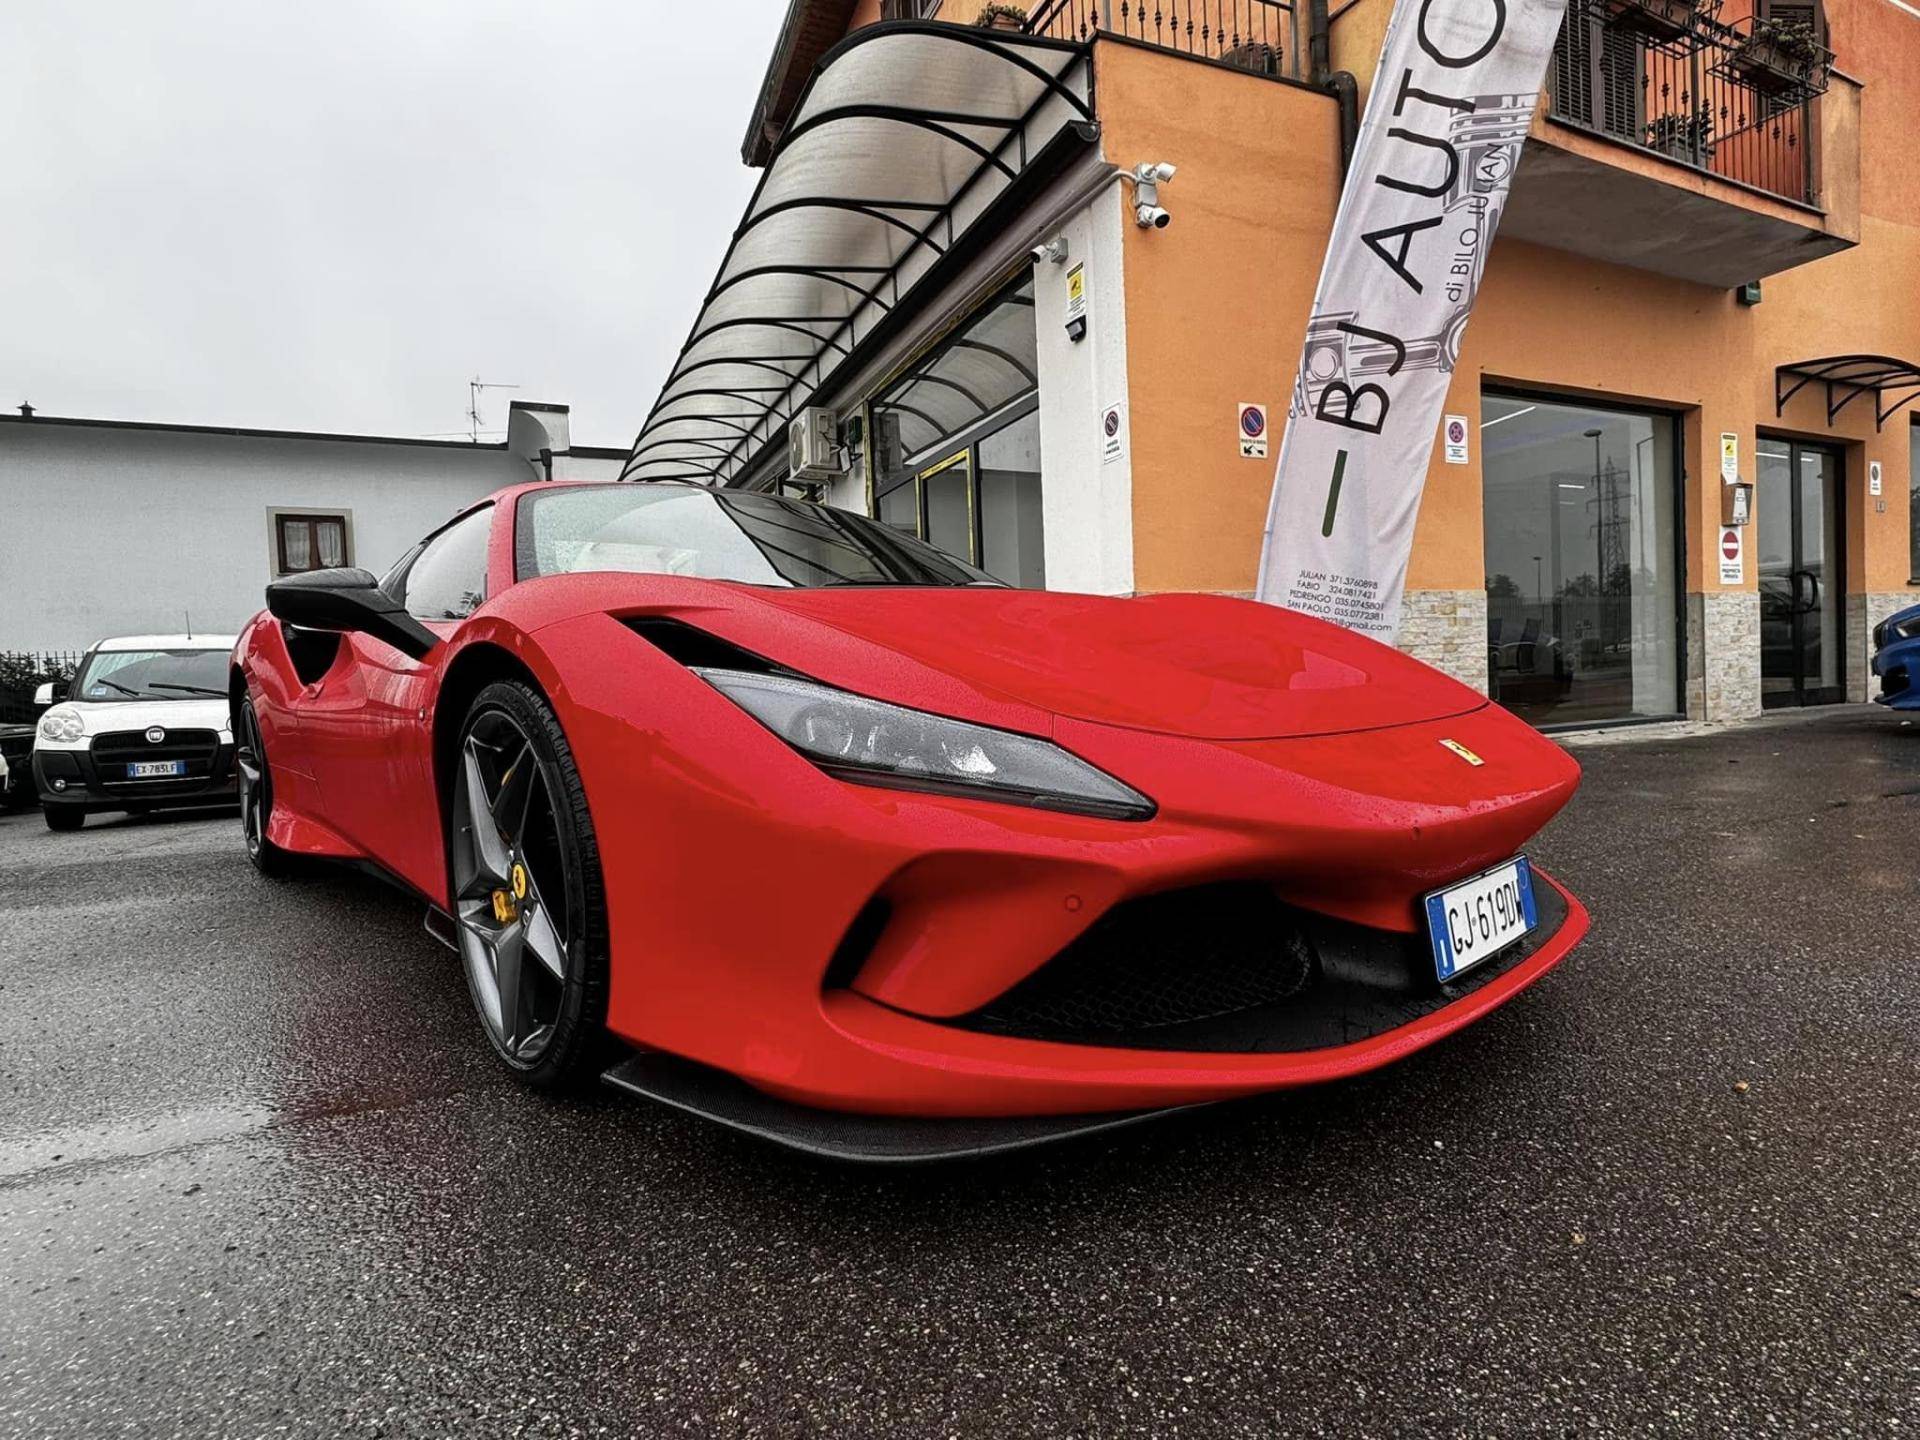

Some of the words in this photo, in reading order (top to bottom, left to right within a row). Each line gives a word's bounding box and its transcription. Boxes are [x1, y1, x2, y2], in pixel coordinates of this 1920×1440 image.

[1467, 142, 1504, 220] JULIAN
[1315, 321, 1406, 435] BJ
[1361, 0, 1507, 295] AUTO
[1451, 227, 1480, 275] BILO
[1448, 282, 1465, 302] di
[1299, 570, 1326, 580] JULIAN
[1297, 580, 1320, 590] FABIO
[1289, 589, 1331, 603] PEDRENGO
[1287, 599, 1301, 608] SAN
[1302, 602, 1331, 614] PAOLO
